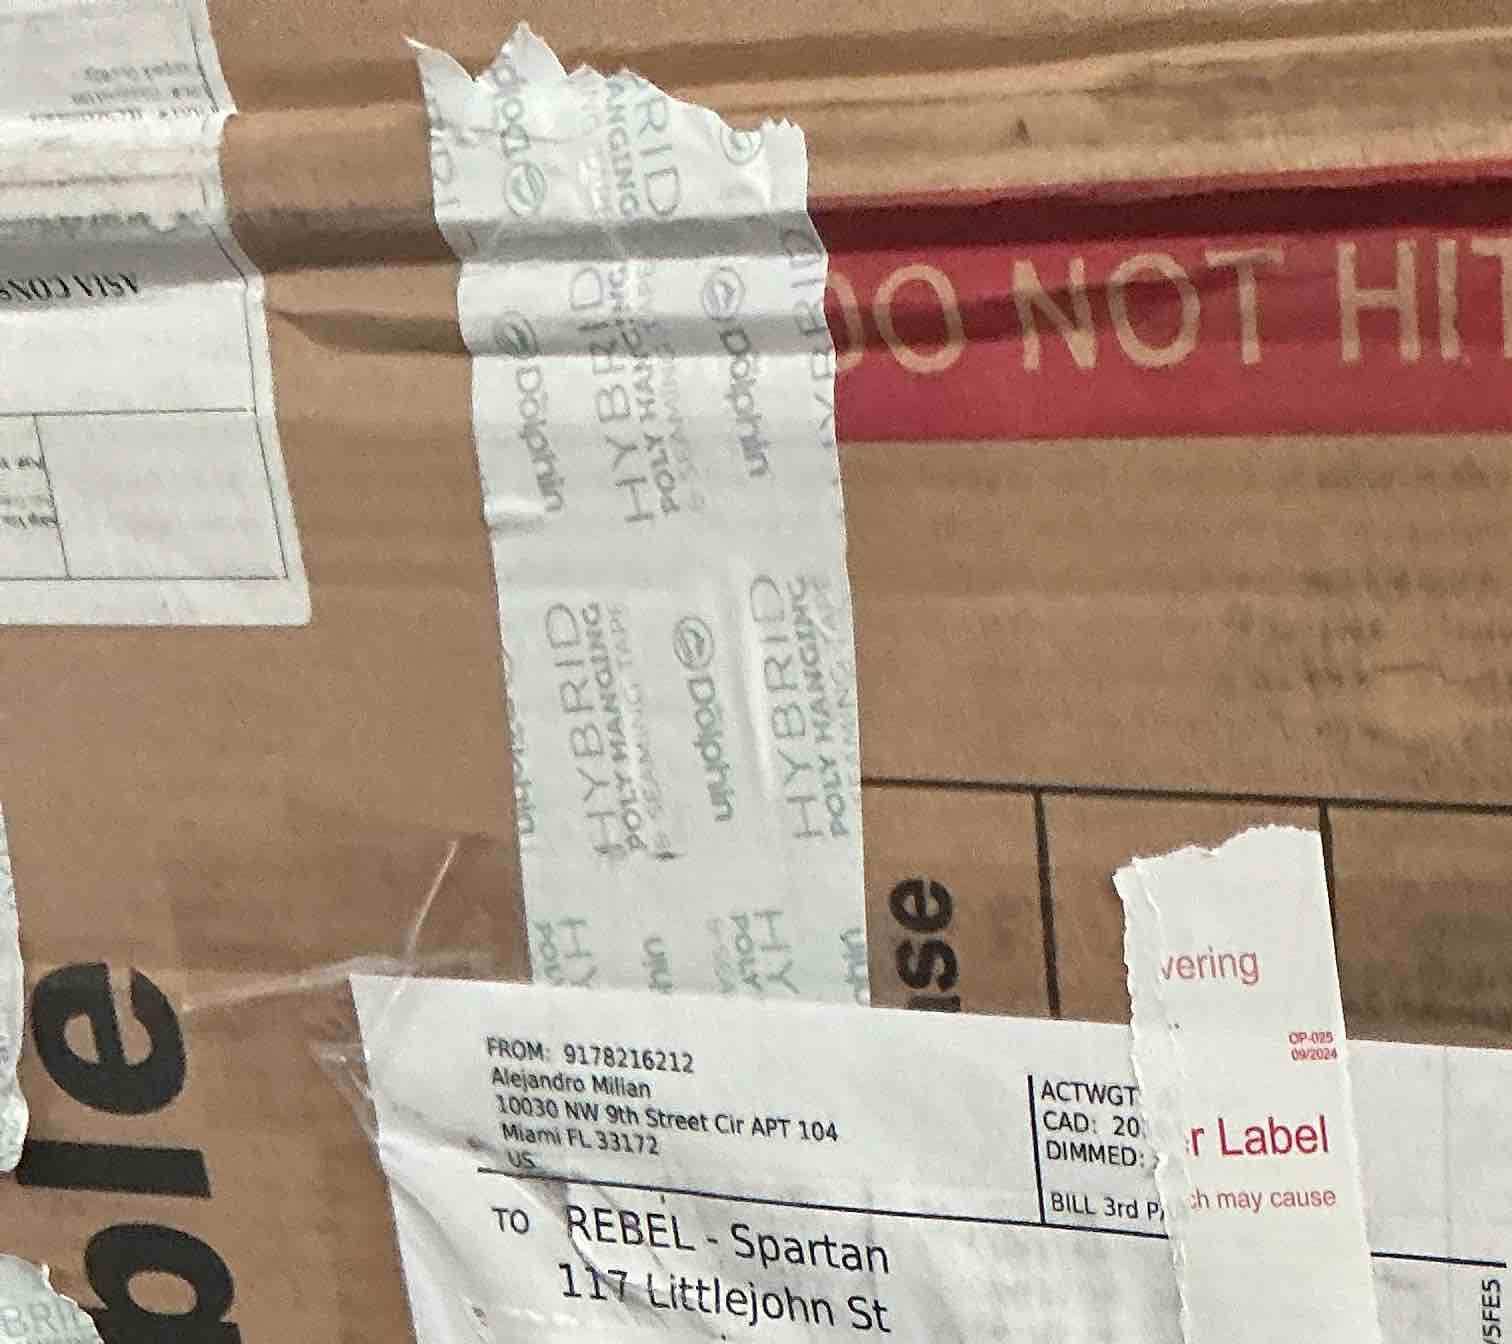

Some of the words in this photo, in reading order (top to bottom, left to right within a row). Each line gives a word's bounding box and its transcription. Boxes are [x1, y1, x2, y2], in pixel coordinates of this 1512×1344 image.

[1013, 247, 1285, 371] NOT
[749, 574, 823, 839] HYBRID
[889, 877, 961, 1012] se
[485, 1036, 551, 1064] FROM:
[563, 1043, 694, 1074] 9178216212
[491, 1066, 586, 1095] Alejandro
[1040, 1079, 1137, 1108] ACTWGT
[495, 1094, 560, 1119] 10030
[564, 1100, 600, 1123] NW
[603, 1102, 638, 1127] 9th
[643, 1106, 709, 1134] Street
[714, 1111, 746, 1136] Cir
[750, 1116, 790, 1141] APT
[798, 1119, 840, 1144] 104
[1042, 1111, 1099, 1136] CAD:
[1218, 1115, 1331, 1158] Label
[502, 1122, 563, 1148] Miami
[567, 1127, 592, 1149] FL
[595, 1129, 660, 1156] 33172
[1045, 1140, 1146, 1169] DIMMED:
[507, 1152, 537, 1169] US
[1050, 1191, 1097, 1217] BILL
[1102, 1196, 1140, 1221] 3rd
[1216, 1190, 1263, 1212] may
[1270, 1187, 1337, 1210] cause
[492, 1207, 531, 1236] TO
[565, 1203, 696, 1252] REBEL
[732, 1223, 890, 1275] Spartan
[557, 1261, 630, 1301] 117
[647, 1273, 836, 1330] Littlejohn
[847, 1294, 892, 1334] St
